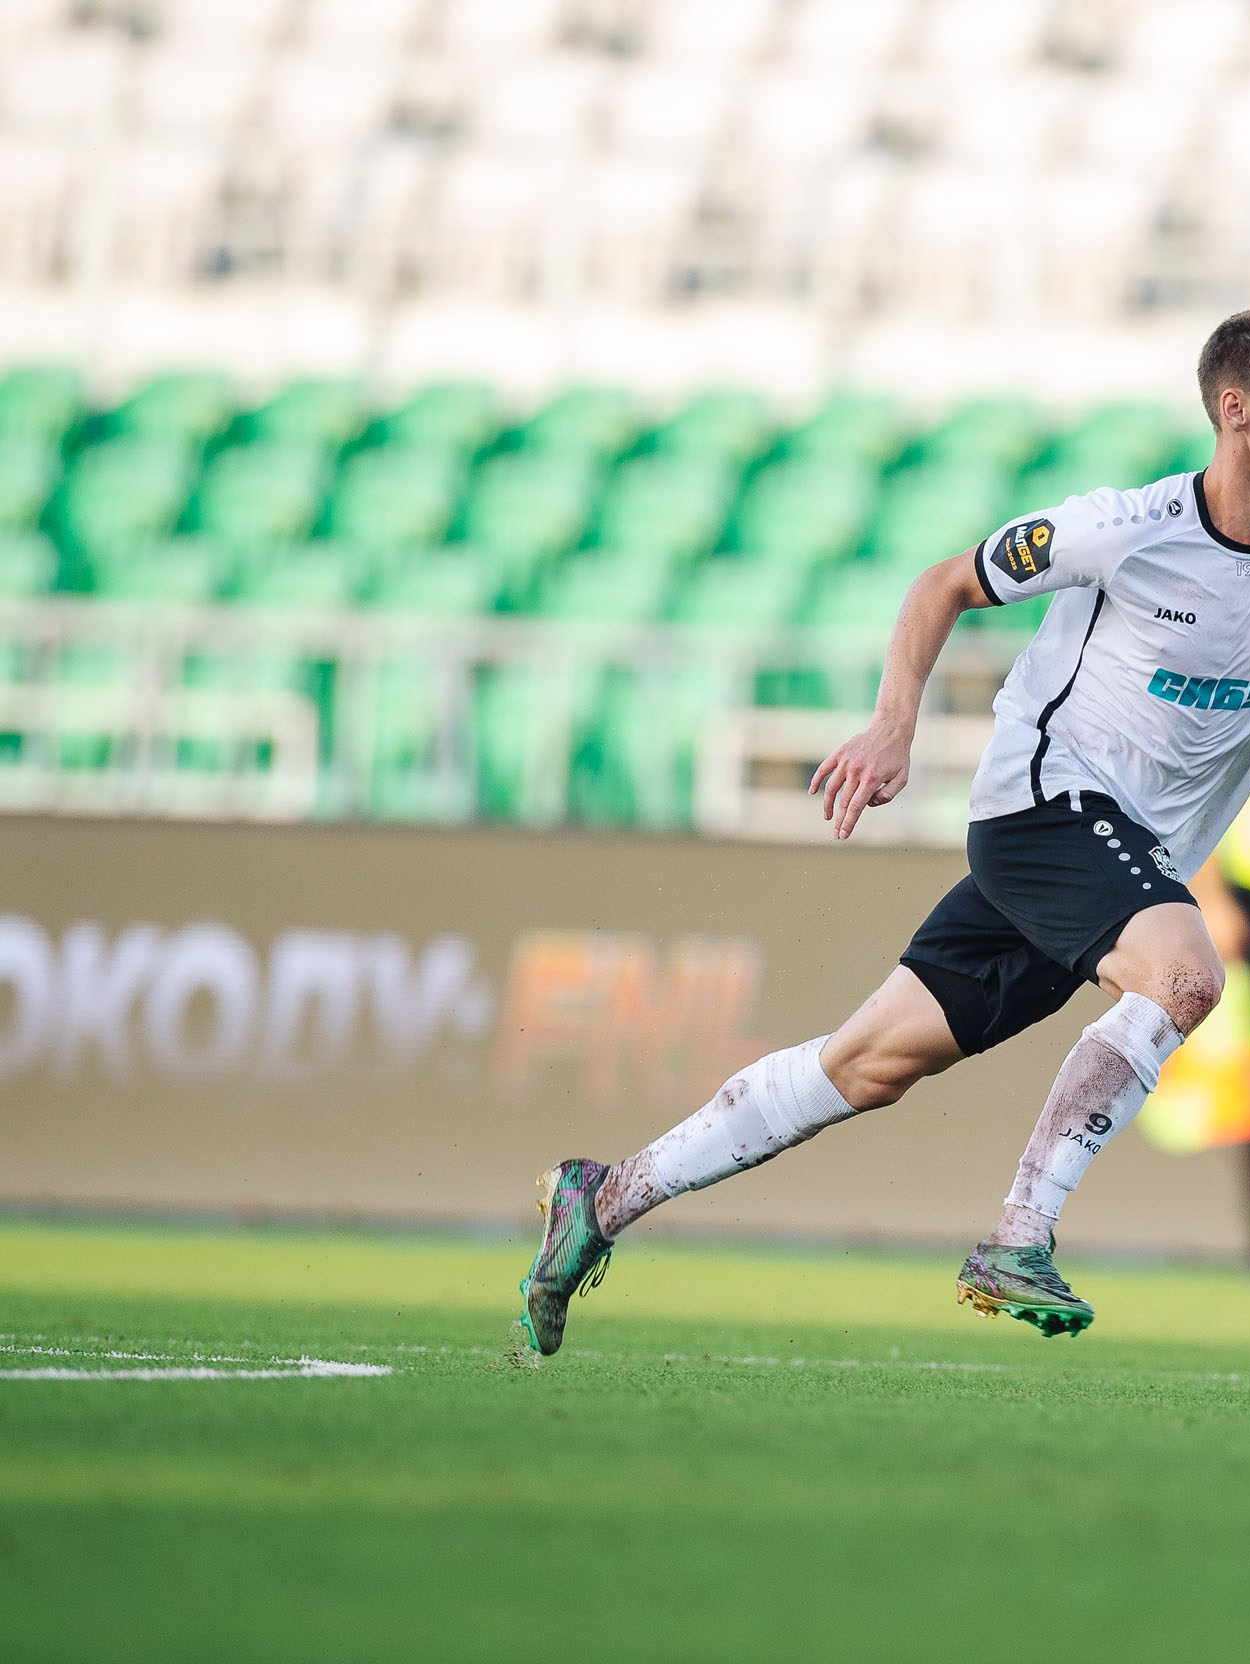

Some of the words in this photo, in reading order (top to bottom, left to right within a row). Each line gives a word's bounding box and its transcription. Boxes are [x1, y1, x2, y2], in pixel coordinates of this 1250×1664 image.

[1154, 608, 1197, 625] JAKO
[1085, 1113, 1112, 1135] 9
[1059, 1128, 1101, 1155] JAKO
